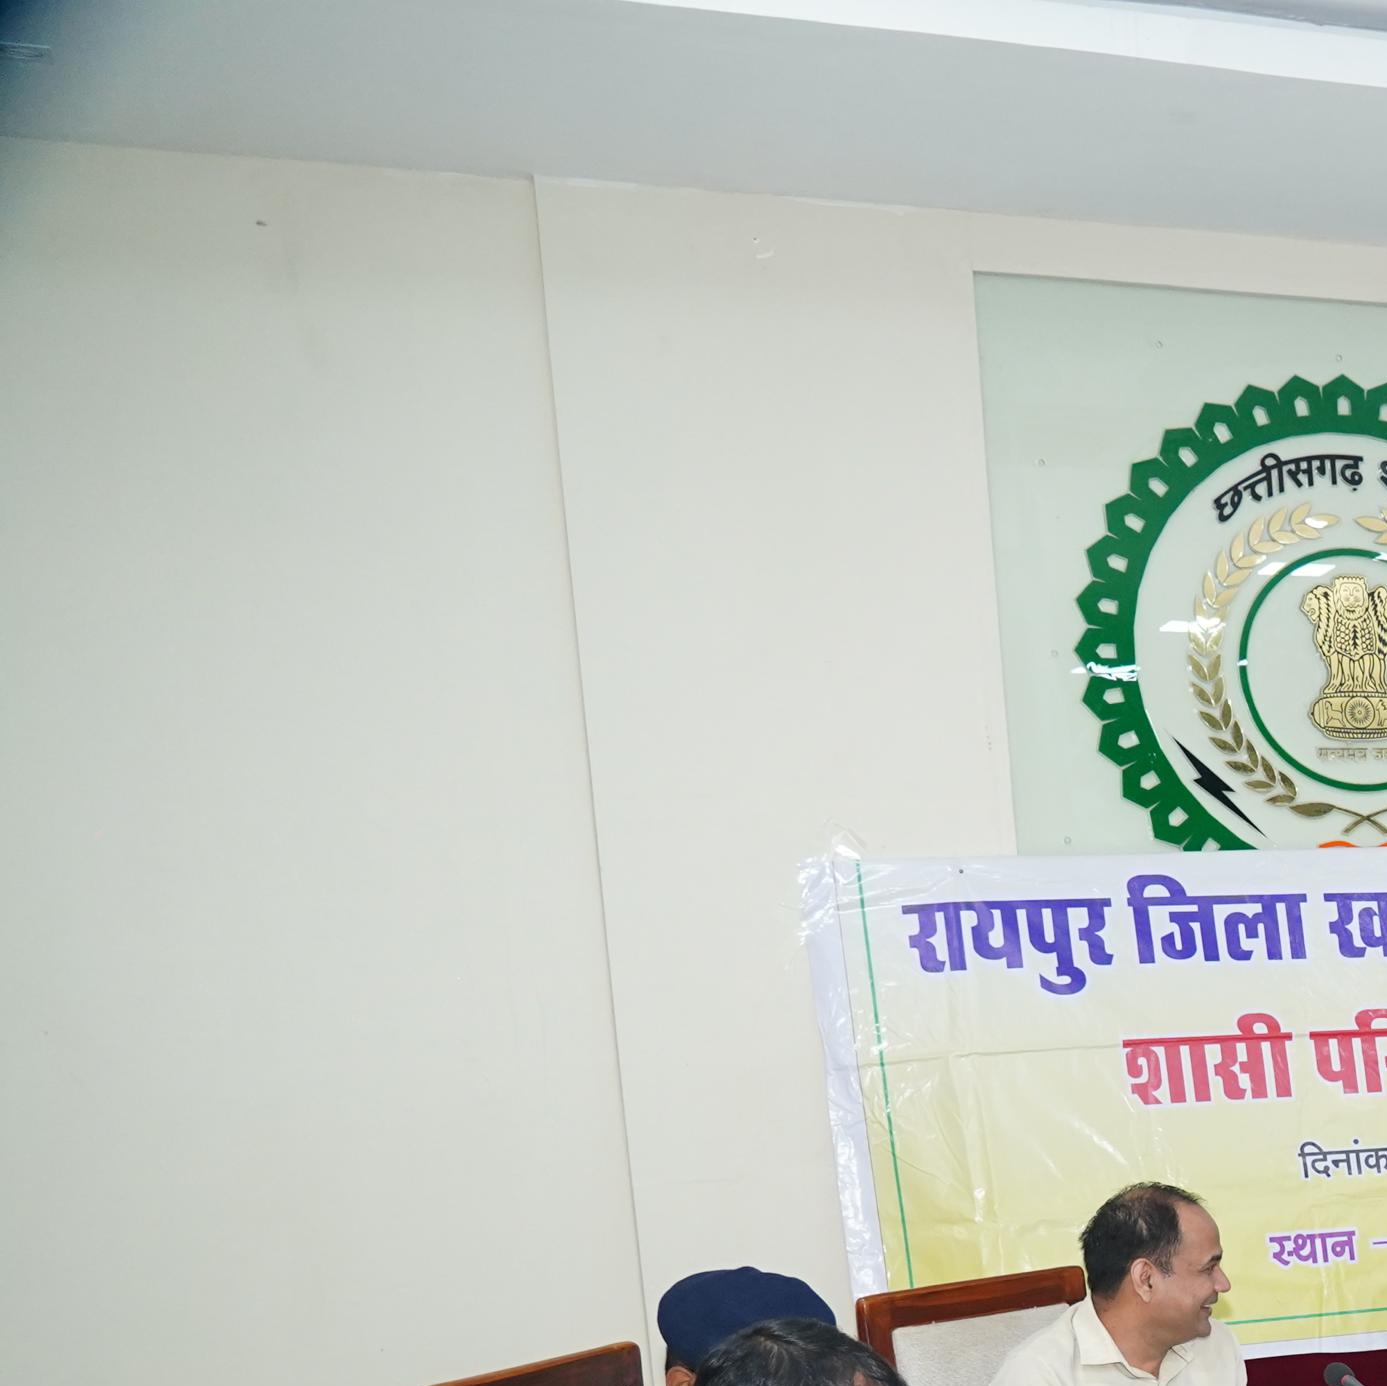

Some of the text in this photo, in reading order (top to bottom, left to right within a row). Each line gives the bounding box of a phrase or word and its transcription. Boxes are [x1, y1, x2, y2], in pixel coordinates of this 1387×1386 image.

[1213, 452, 1364, 523] छत्तीसगढ़
[901, 897, 1115, 996] रायपुर
[1126, 873, 1308, 965] जिला
[1122, 1012, 1293, 1106] शासी
[1269, 1230, 1356, 1266] स्थान
